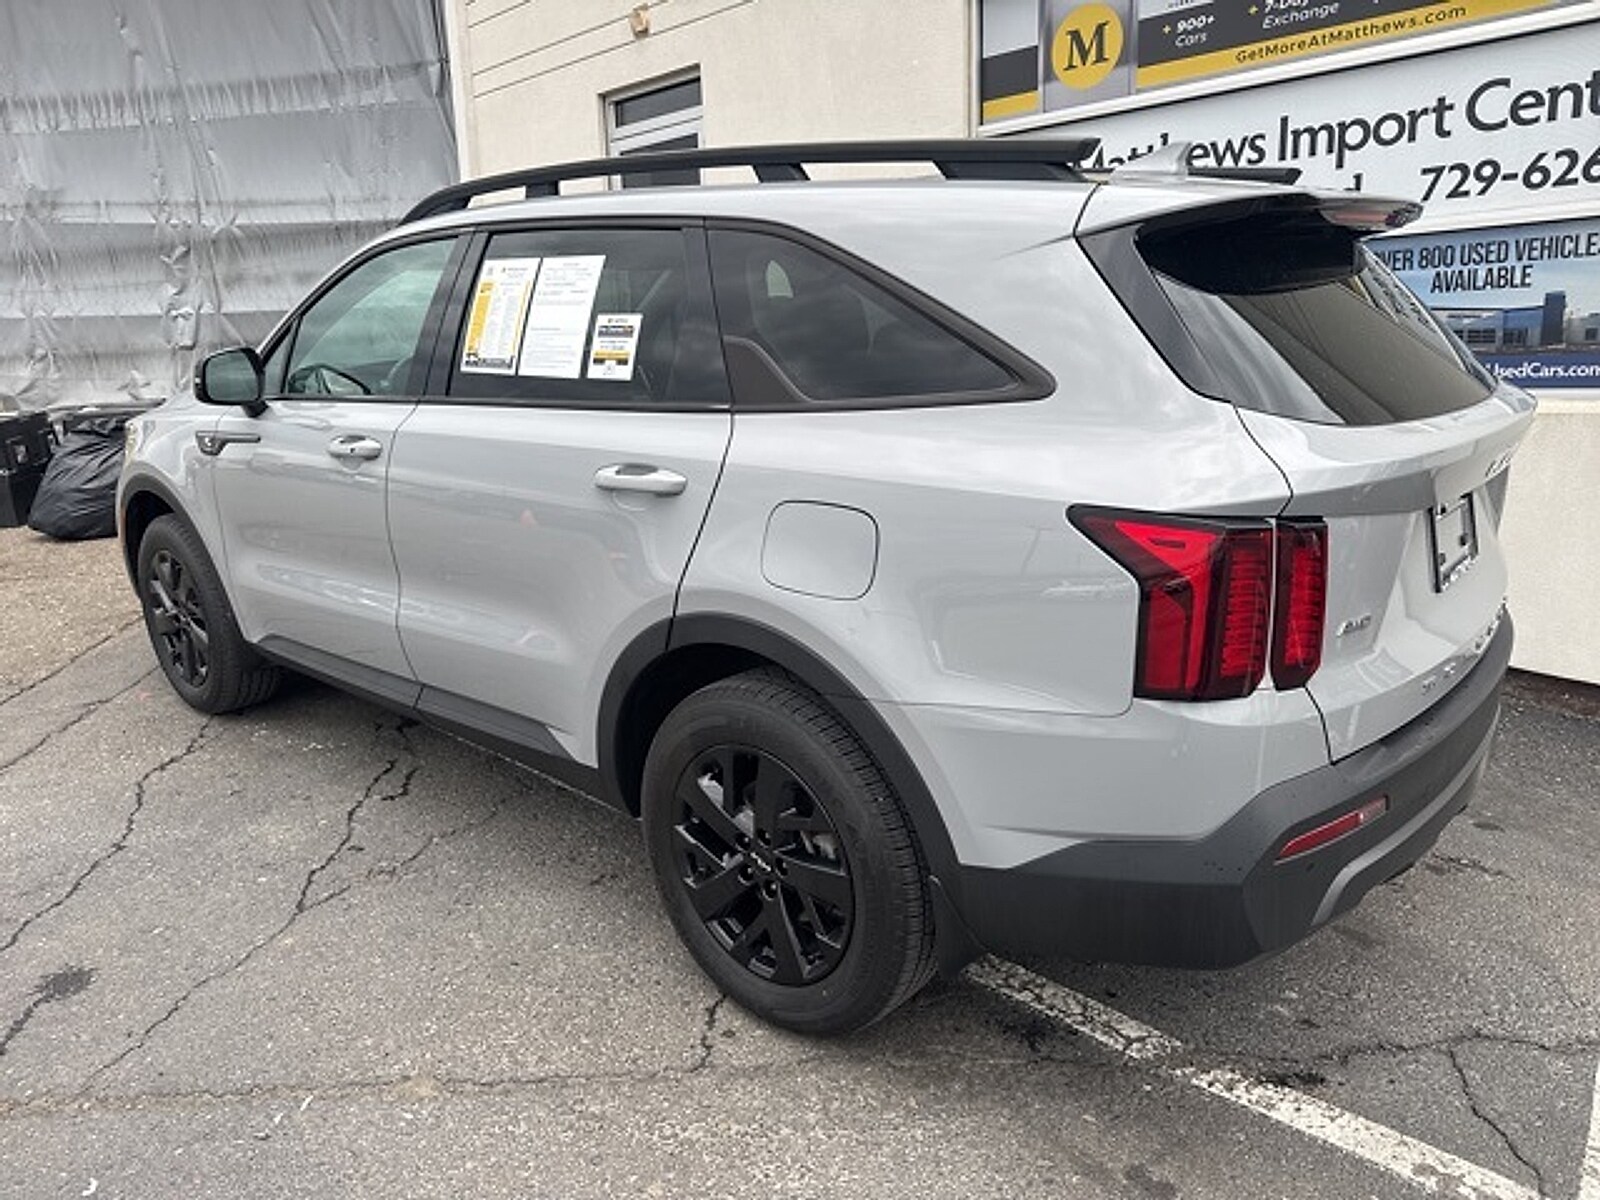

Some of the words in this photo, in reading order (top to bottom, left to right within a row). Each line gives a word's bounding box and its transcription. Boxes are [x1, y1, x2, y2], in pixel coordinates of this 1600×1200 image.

[1235, 5, 1467, 64] GetMoreAtMatthews.com
[1262, 2, 1340, 29] Exchange
[1063, 20, 1110, 71] M
[1175, 32, 1208, 47] Cars
[1277, 95, 1455, 169] Import
[1373, 249, 1414, 271] VER
[1417, 244, 1454, 269] 800
[1459, 239, 1510, 267] USED
[1514, 231, 1600, 262] VEHICLE
[1429, 265, 1534, 294] AVAILABLE
